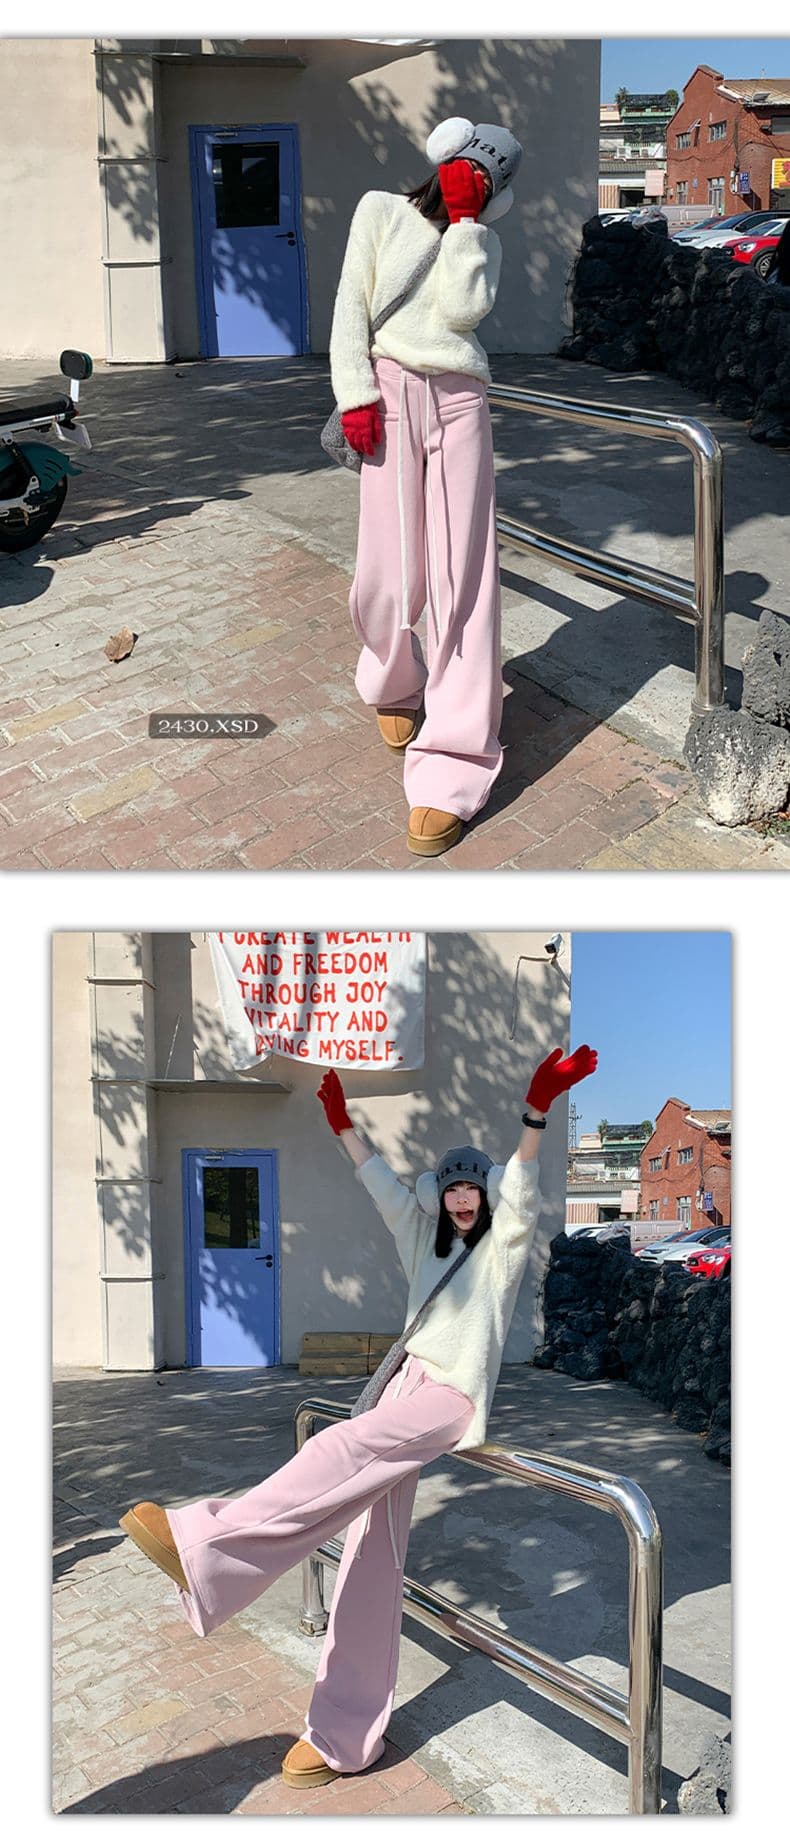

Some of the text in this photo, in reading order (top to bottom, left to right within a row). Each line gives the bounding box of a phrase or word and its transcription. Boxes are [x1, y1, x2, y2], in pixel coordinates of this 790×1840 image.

[242, 952, 388, 976] AND FREEDOM
[237, 979, 388, 1005] THROUGH JOY
[244, 1007, 388, 1033] VITALITY AND
[319, 1039, 404, 1061] MYSELF.
